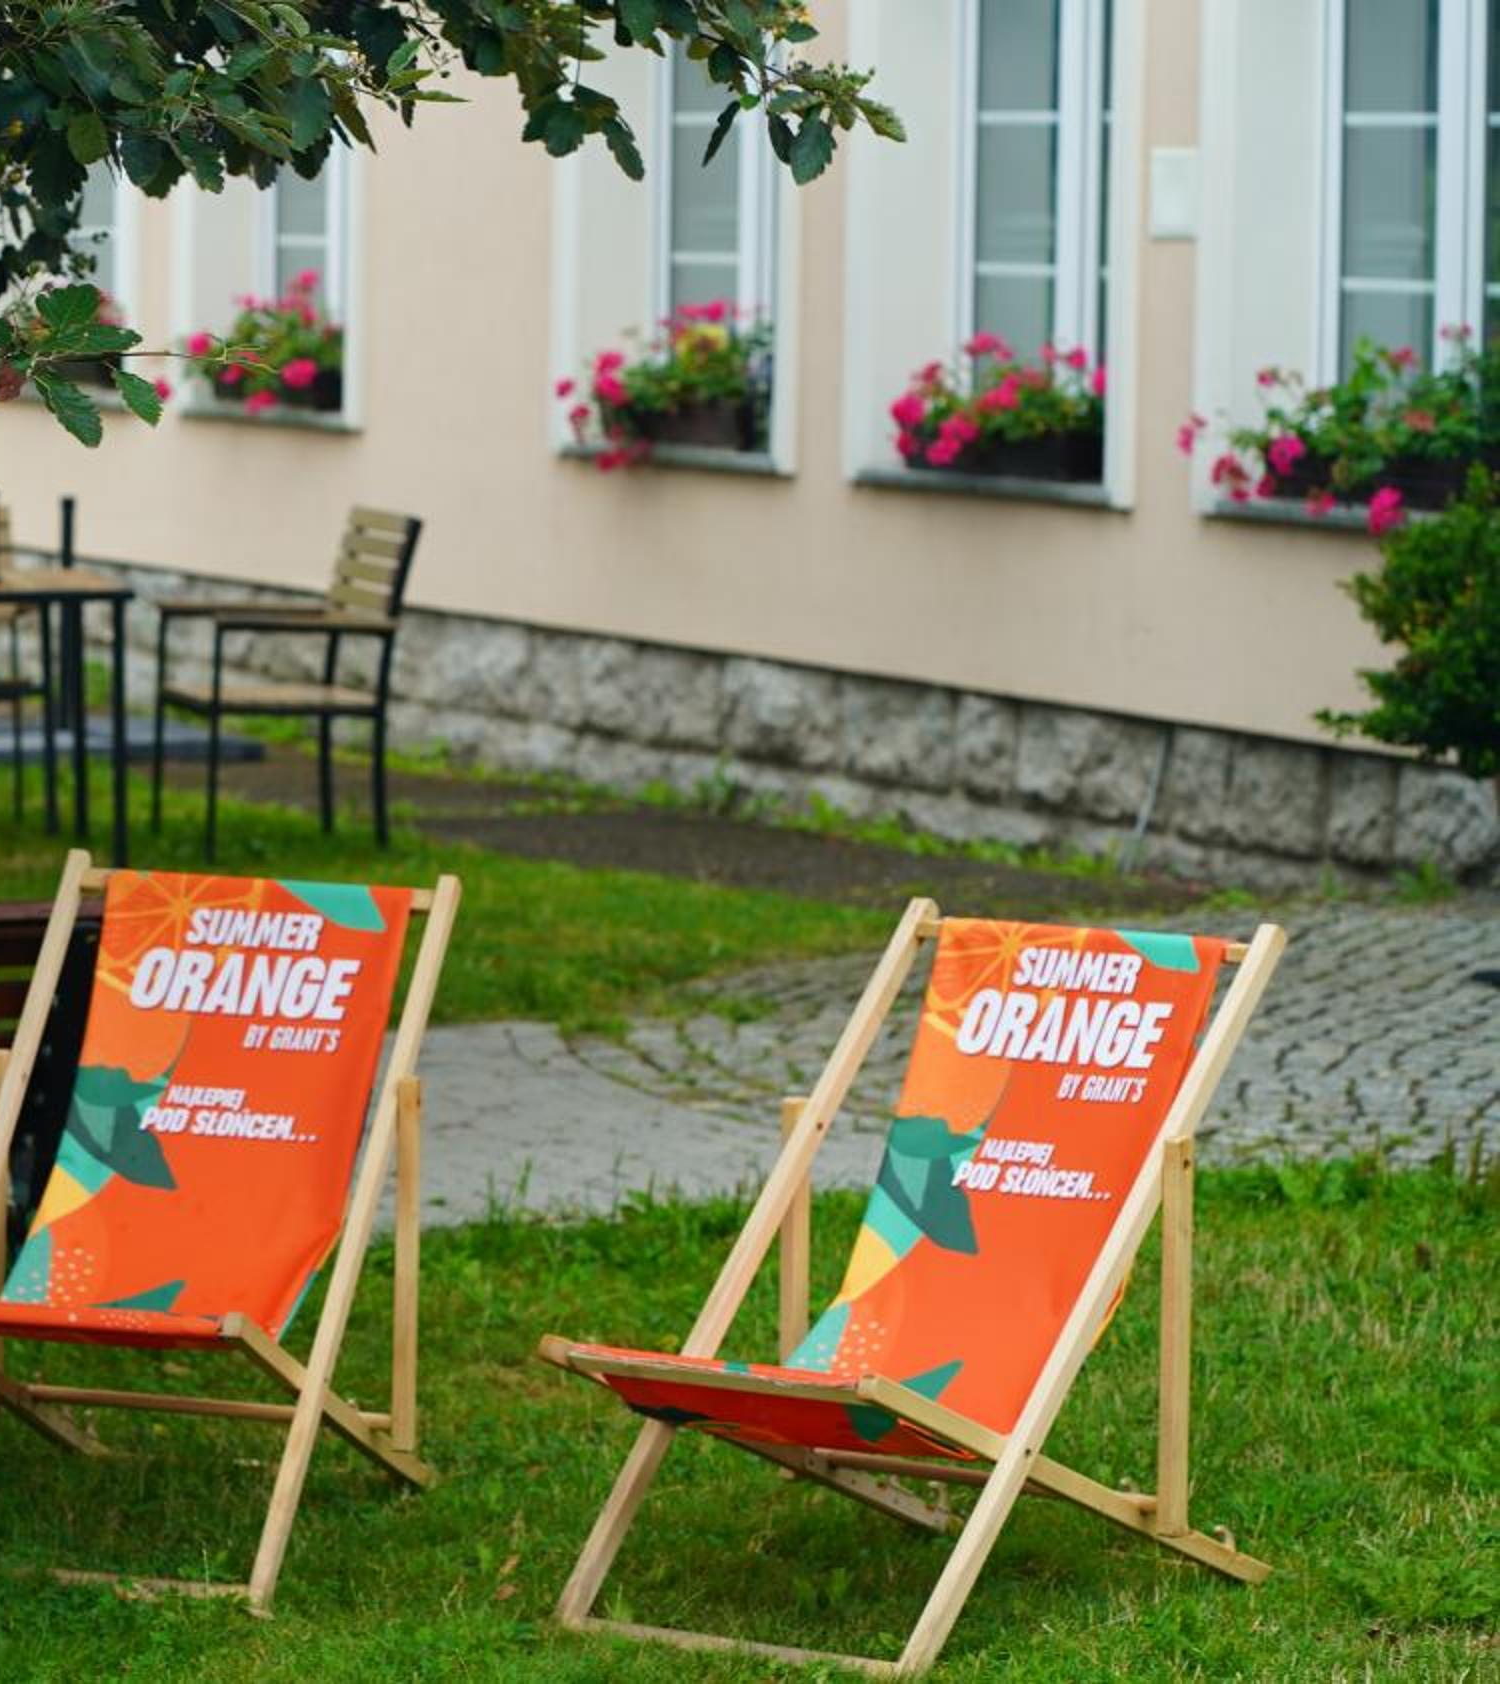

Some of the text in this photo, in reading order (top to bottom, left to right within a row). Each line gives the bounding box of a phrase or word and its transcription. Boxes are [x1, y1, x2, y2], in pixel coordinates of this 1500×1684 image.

[185, 908, 324, 950] SUMMER
[130, 947, 361, 1020] ORANGE
[1013, 947, 1142, 993] SUMMER
[243, 1024, 341, 1052] BY GRANT'S
[956, 988, 1173, 1069] ORANGE
[166, 1085, 246, 1110] NAJLEPIEJ
[1058, 1074, 1147, 1103] BY GRANT'S
[138, 1106, 189, 1132] POD
[981, 1138, 1055, 1166] NAJLEPIEJ
[951, 1161, 1000, 1190] POD
